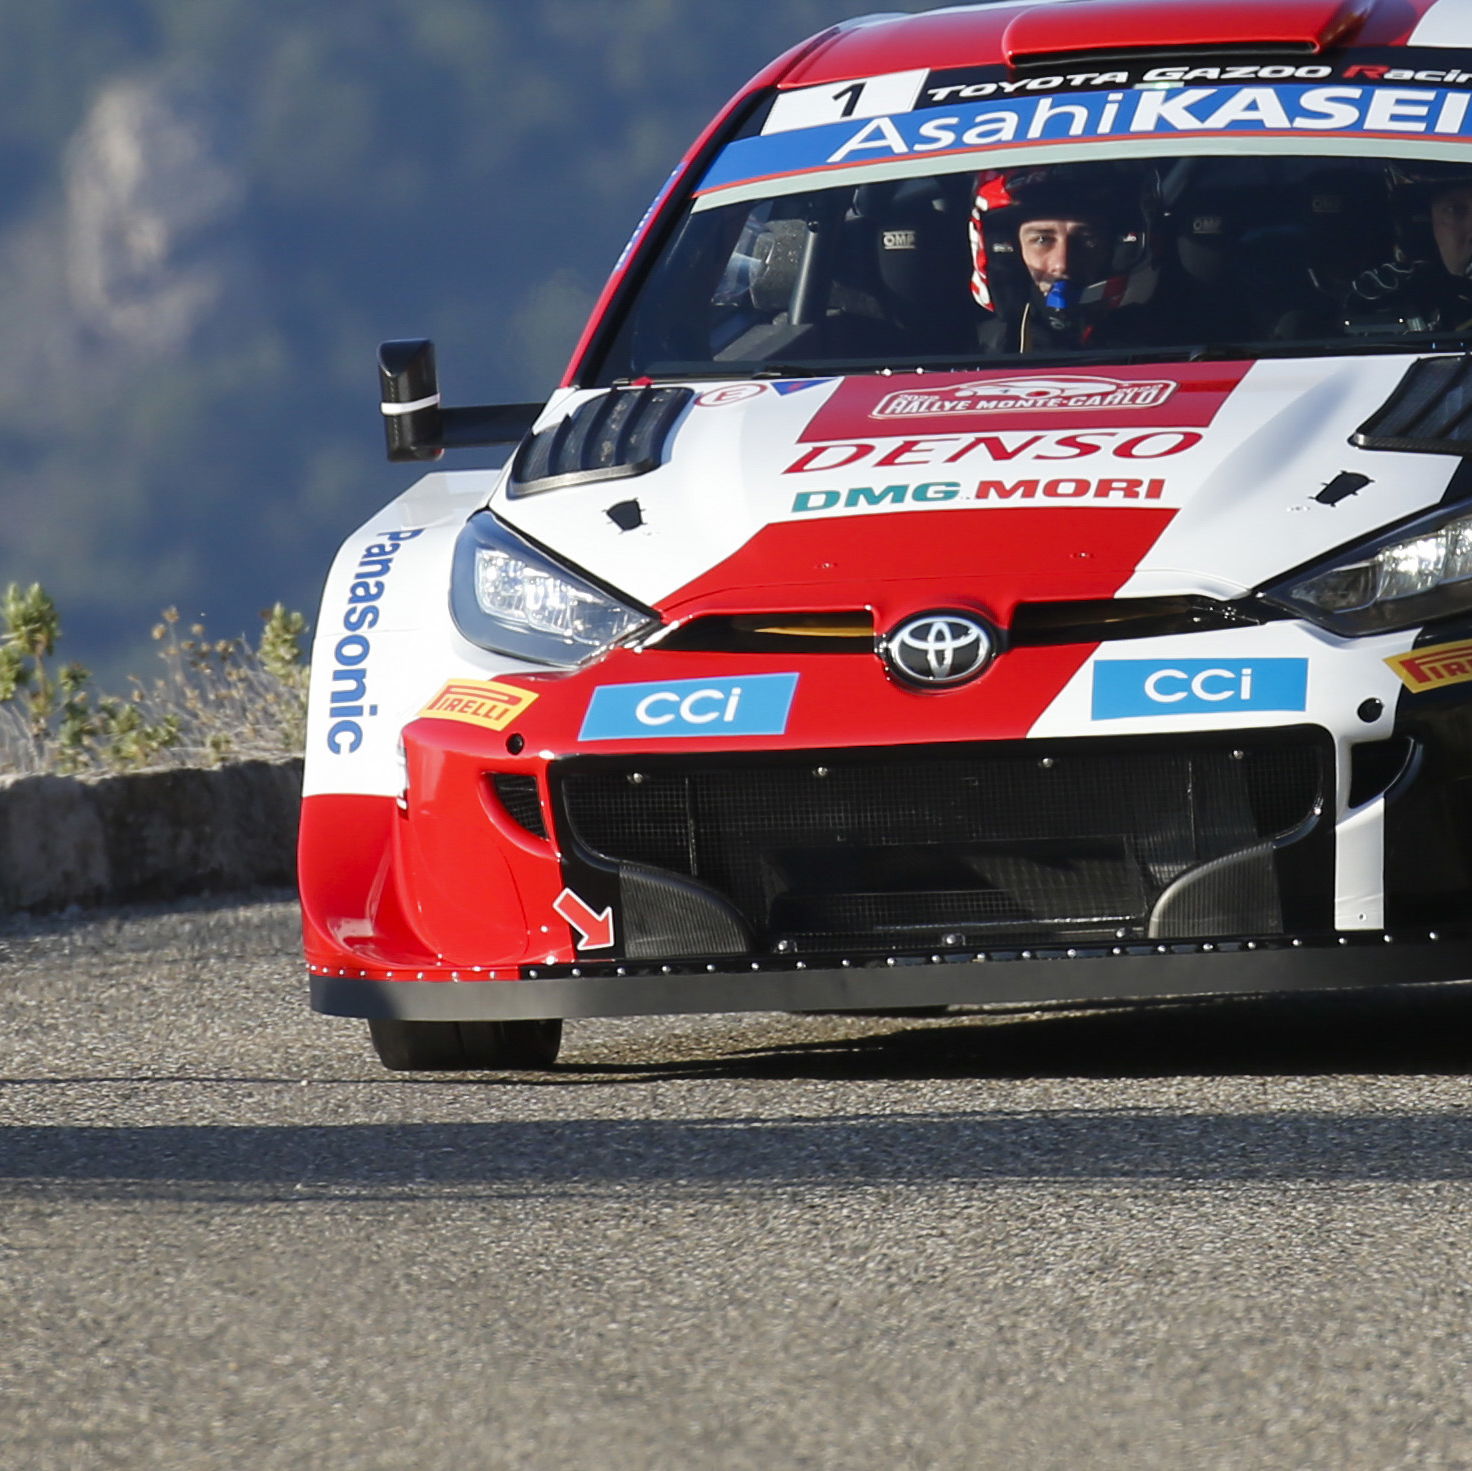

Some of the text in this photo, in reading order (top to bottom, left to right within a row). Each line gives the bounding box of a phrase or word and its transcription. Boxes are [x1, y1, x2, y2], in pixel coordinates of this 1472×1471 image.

[831, 82, 864, 119] 1
[927, 70, 1129, 102] TOYOTA
[1142, 64, 1333, 82] GAZOO
[826, 86, 1472, 164] AsahiKASEI
[884, 395, 970, 415] RALLYE
[781, 431, 1203, 474] DENSO
[791, 478, 1166, 513] DMG MORI
[327, 528, 426, 755] Panasonic
[427, 684, 523, 721] PIRELLI
